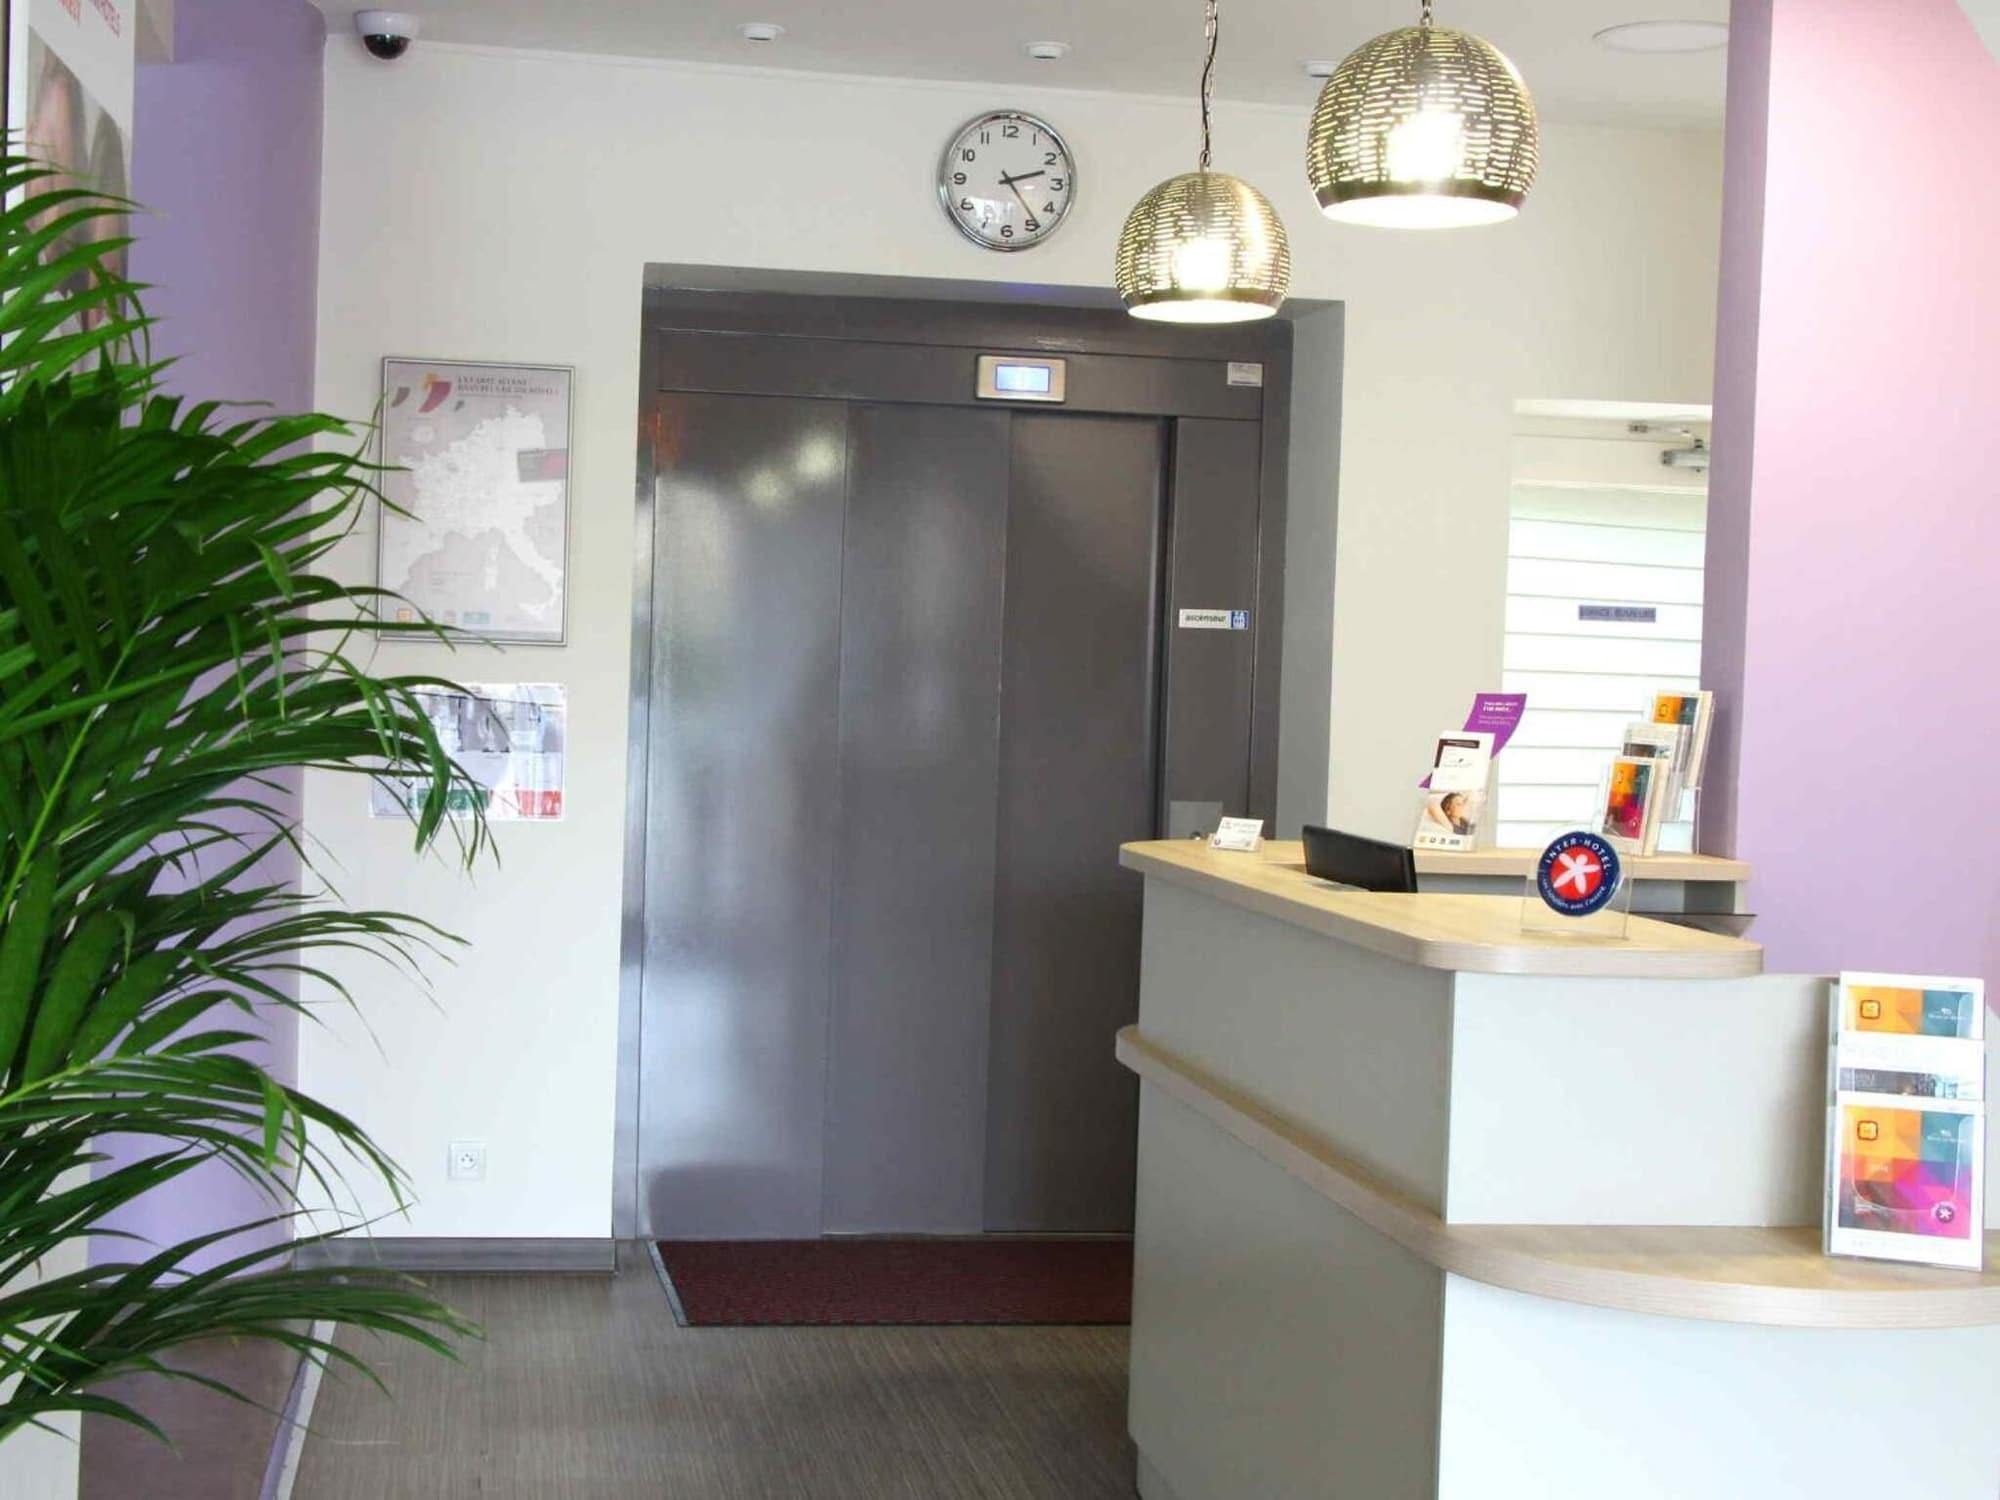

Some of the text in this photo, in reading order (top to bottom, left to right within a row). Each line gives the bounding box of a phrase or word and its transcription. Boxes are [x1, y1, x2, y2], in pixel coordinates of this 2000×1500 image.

[980, 131, 990, 145] 11
[1002, 124, 1020, 138] 12
[1032, 132, 1037, 146] 1
[962, 148, 975, 162] 10
[1044, 152, 1057, 166] 2
[953, 172, 967, 185] 9
[1050, 178, 1064, 191] 3
[1042, 201, 1056, 213] 4
[1000, 224, 1014, 238] 6
[1024, 219, 1038, 232] 5
